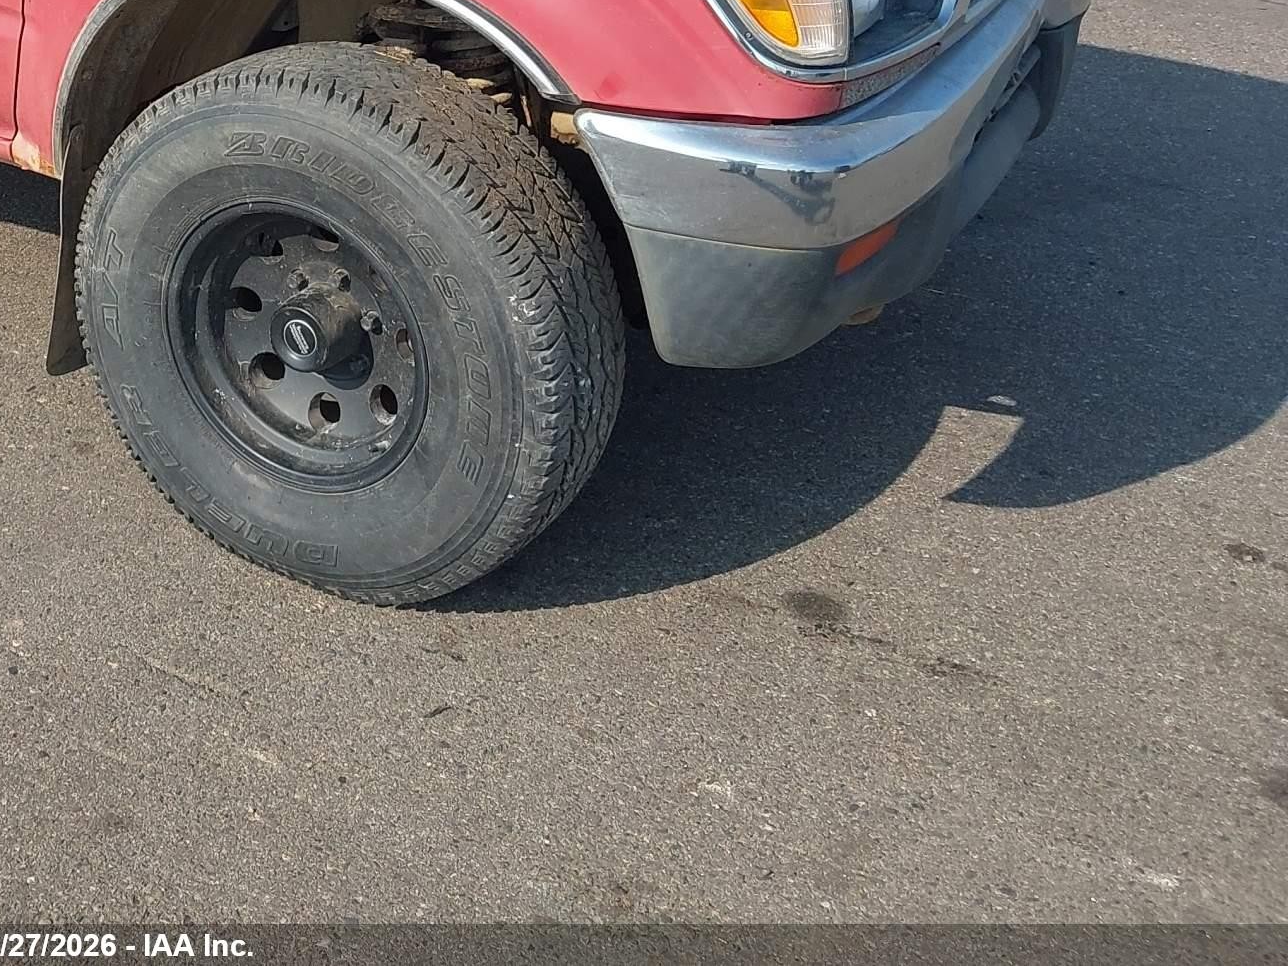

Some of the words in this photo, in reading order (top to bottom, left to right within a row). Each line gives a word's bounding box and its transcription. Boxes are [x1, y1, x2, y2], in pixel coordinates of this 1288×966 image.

[100, 227, 125, 351] A/T
[223, 130, 493, 486] BRIDGESTONE
[120, 384, 340, 568] DUELER
